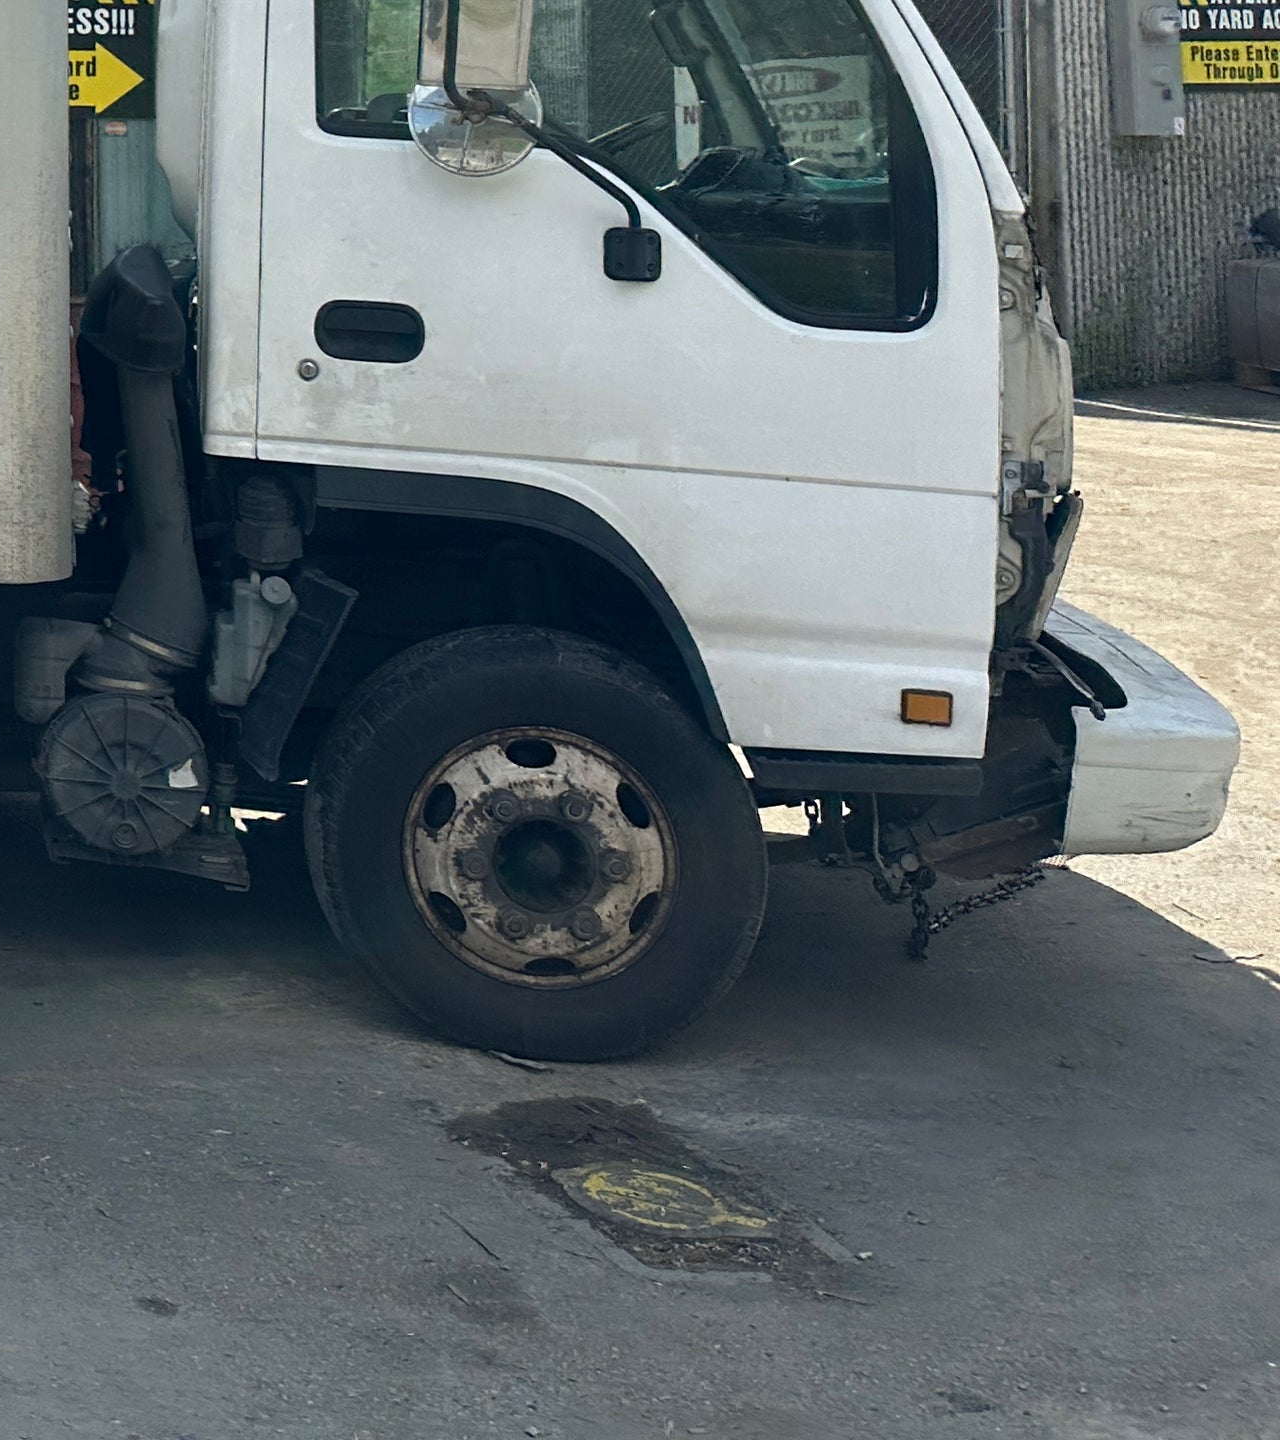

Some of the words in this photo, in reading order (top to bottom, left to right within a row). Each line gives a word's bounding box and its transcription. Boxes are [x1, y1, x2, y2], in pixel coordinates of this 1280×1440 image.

[1207, 9, 1254, 30] YARD
[1191, 45, 1239, 61] Please
[1204, 63, 1263, 81] Through
